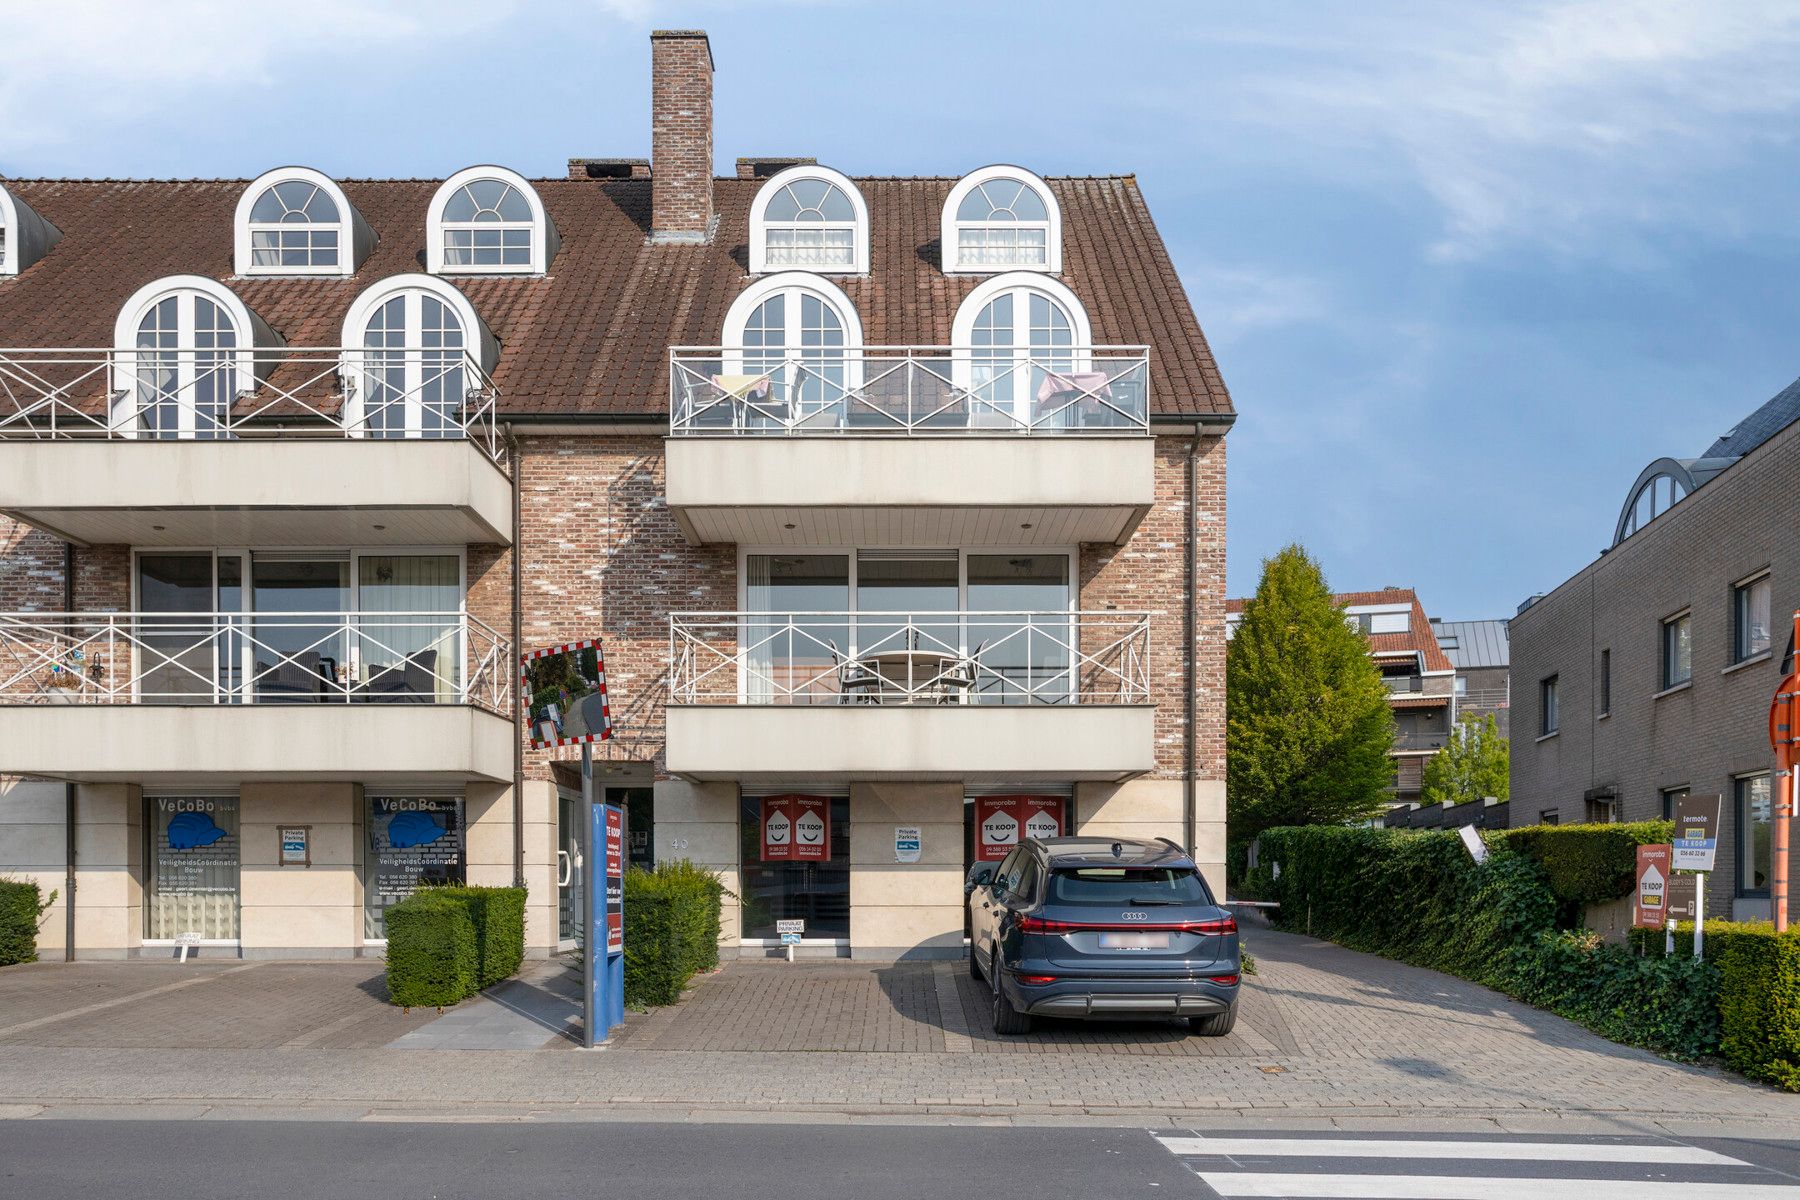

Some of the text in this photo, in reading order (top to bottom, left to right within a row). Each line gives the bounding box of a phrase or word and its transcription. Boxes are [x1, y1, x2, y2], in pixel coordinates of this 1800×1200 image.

[158, 799, 215, 812] VeCoBo
[380, 798, 437, 811] VeCoBo
[672, 839, 689, 850] 40
[1642, 850, 1665, 858] immoroba
[1642, 882, 1648, 890] TE
[1649, 882, 1662, 890] KOOP
[1643, 895, 1659, 904] GARAGE
